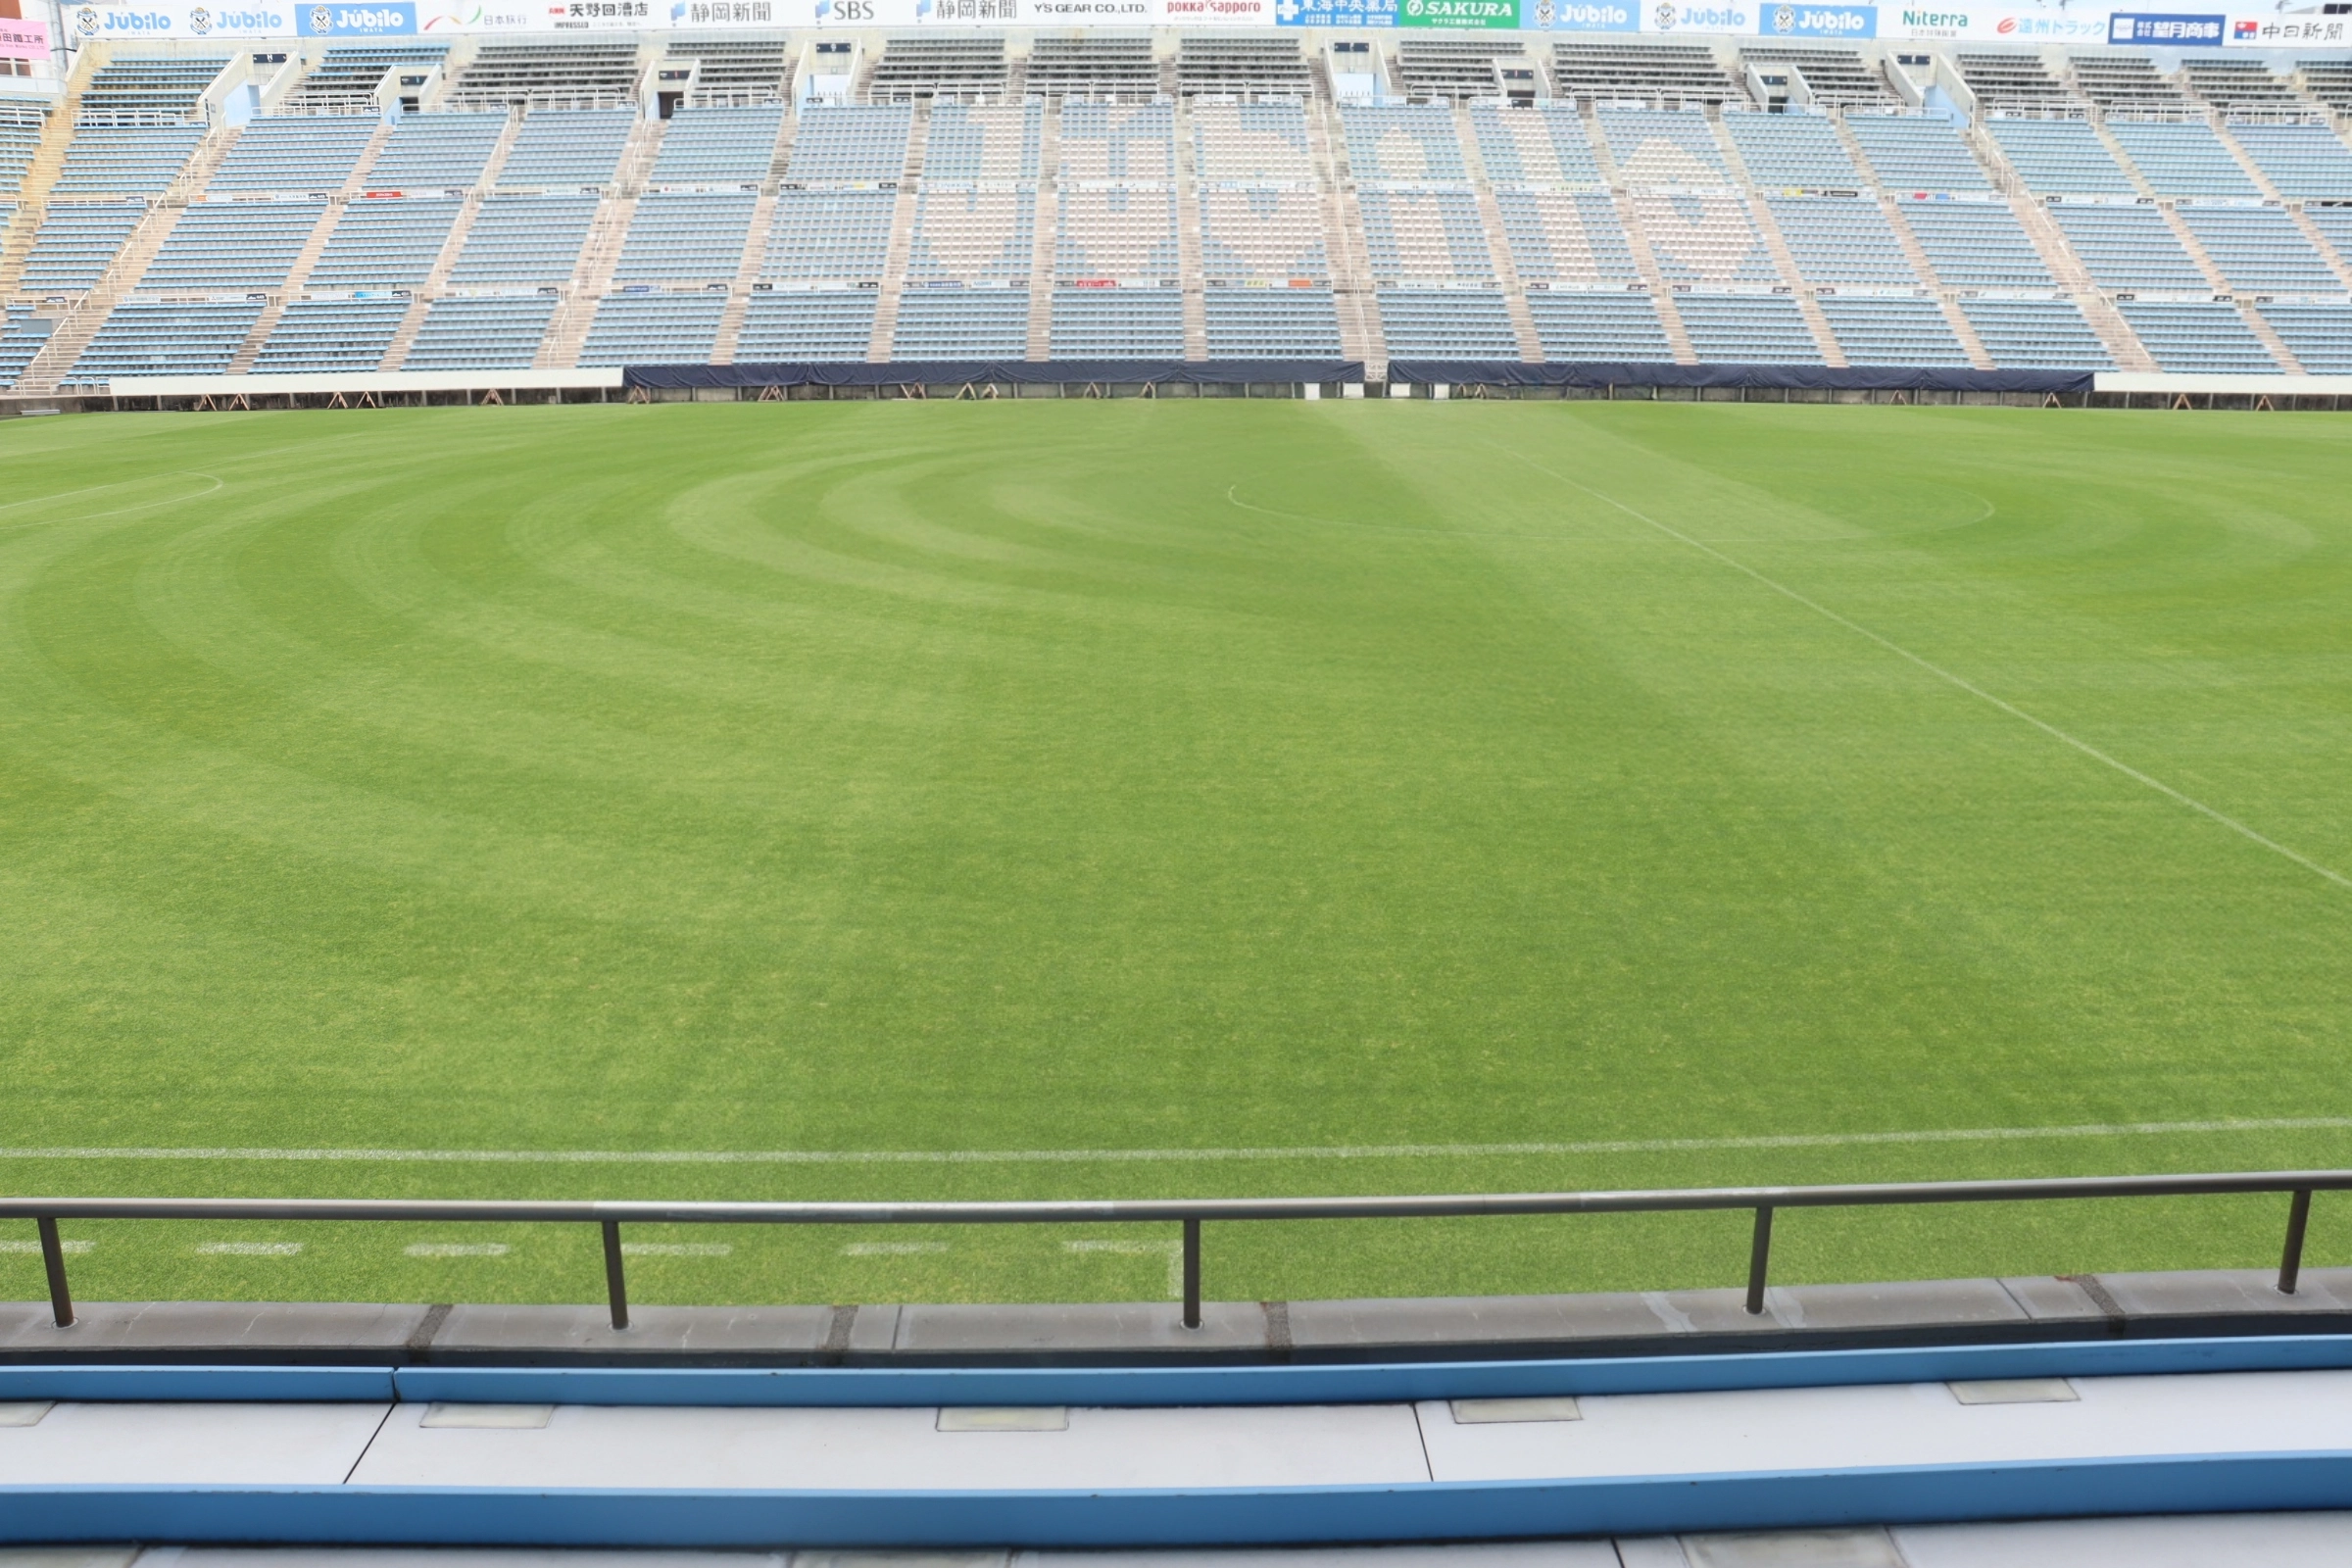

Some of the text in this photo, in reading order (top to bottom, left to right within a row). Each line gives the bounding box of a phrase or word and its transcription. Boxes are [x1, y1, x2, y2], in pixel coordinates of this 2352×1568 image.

[691, 2, 771, 23] 静岡新聞
[834, 0, 874, 20] SBS
[936, 0, 1017, 19] 静岡新聞
[1055, 3, 1092, 13] GEAR
[1300, 0, 1397, 12] 東海中央薬局
[1425, 2, 1513, 17] SAKURA
[484, 15, 527, 25] 日本旅行
[1902, 9, 1969, 27] Niterra
[2018, 18, 2106, 35] 遠州トラック
[2262, 22, 2343, 40] 中日新聞
